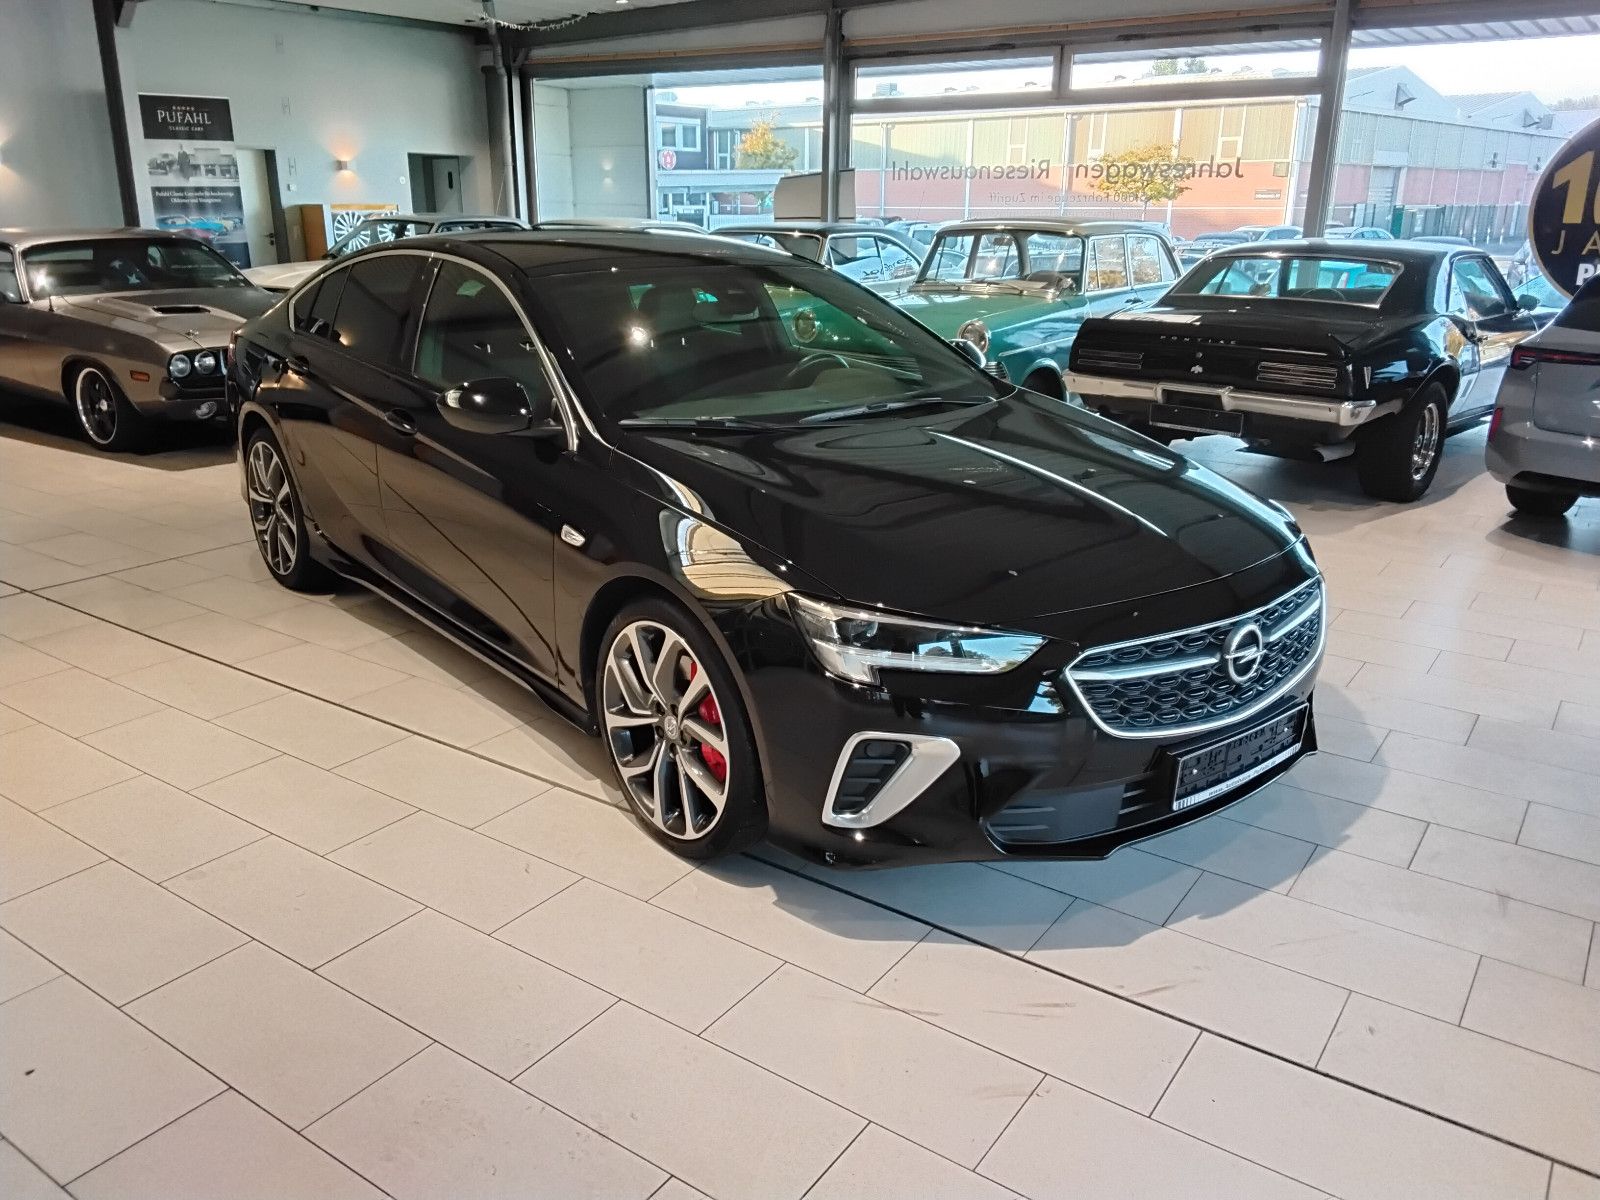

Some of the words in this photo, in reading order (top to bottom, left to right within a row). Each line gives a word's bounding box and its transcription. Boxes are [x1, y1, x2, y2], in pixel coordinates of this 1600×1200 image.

[157, 109, 212, 125] PUFAHL
[1575, 262, 1600, 286] P
[1159, 335, 1237, 346] PONTIAC
